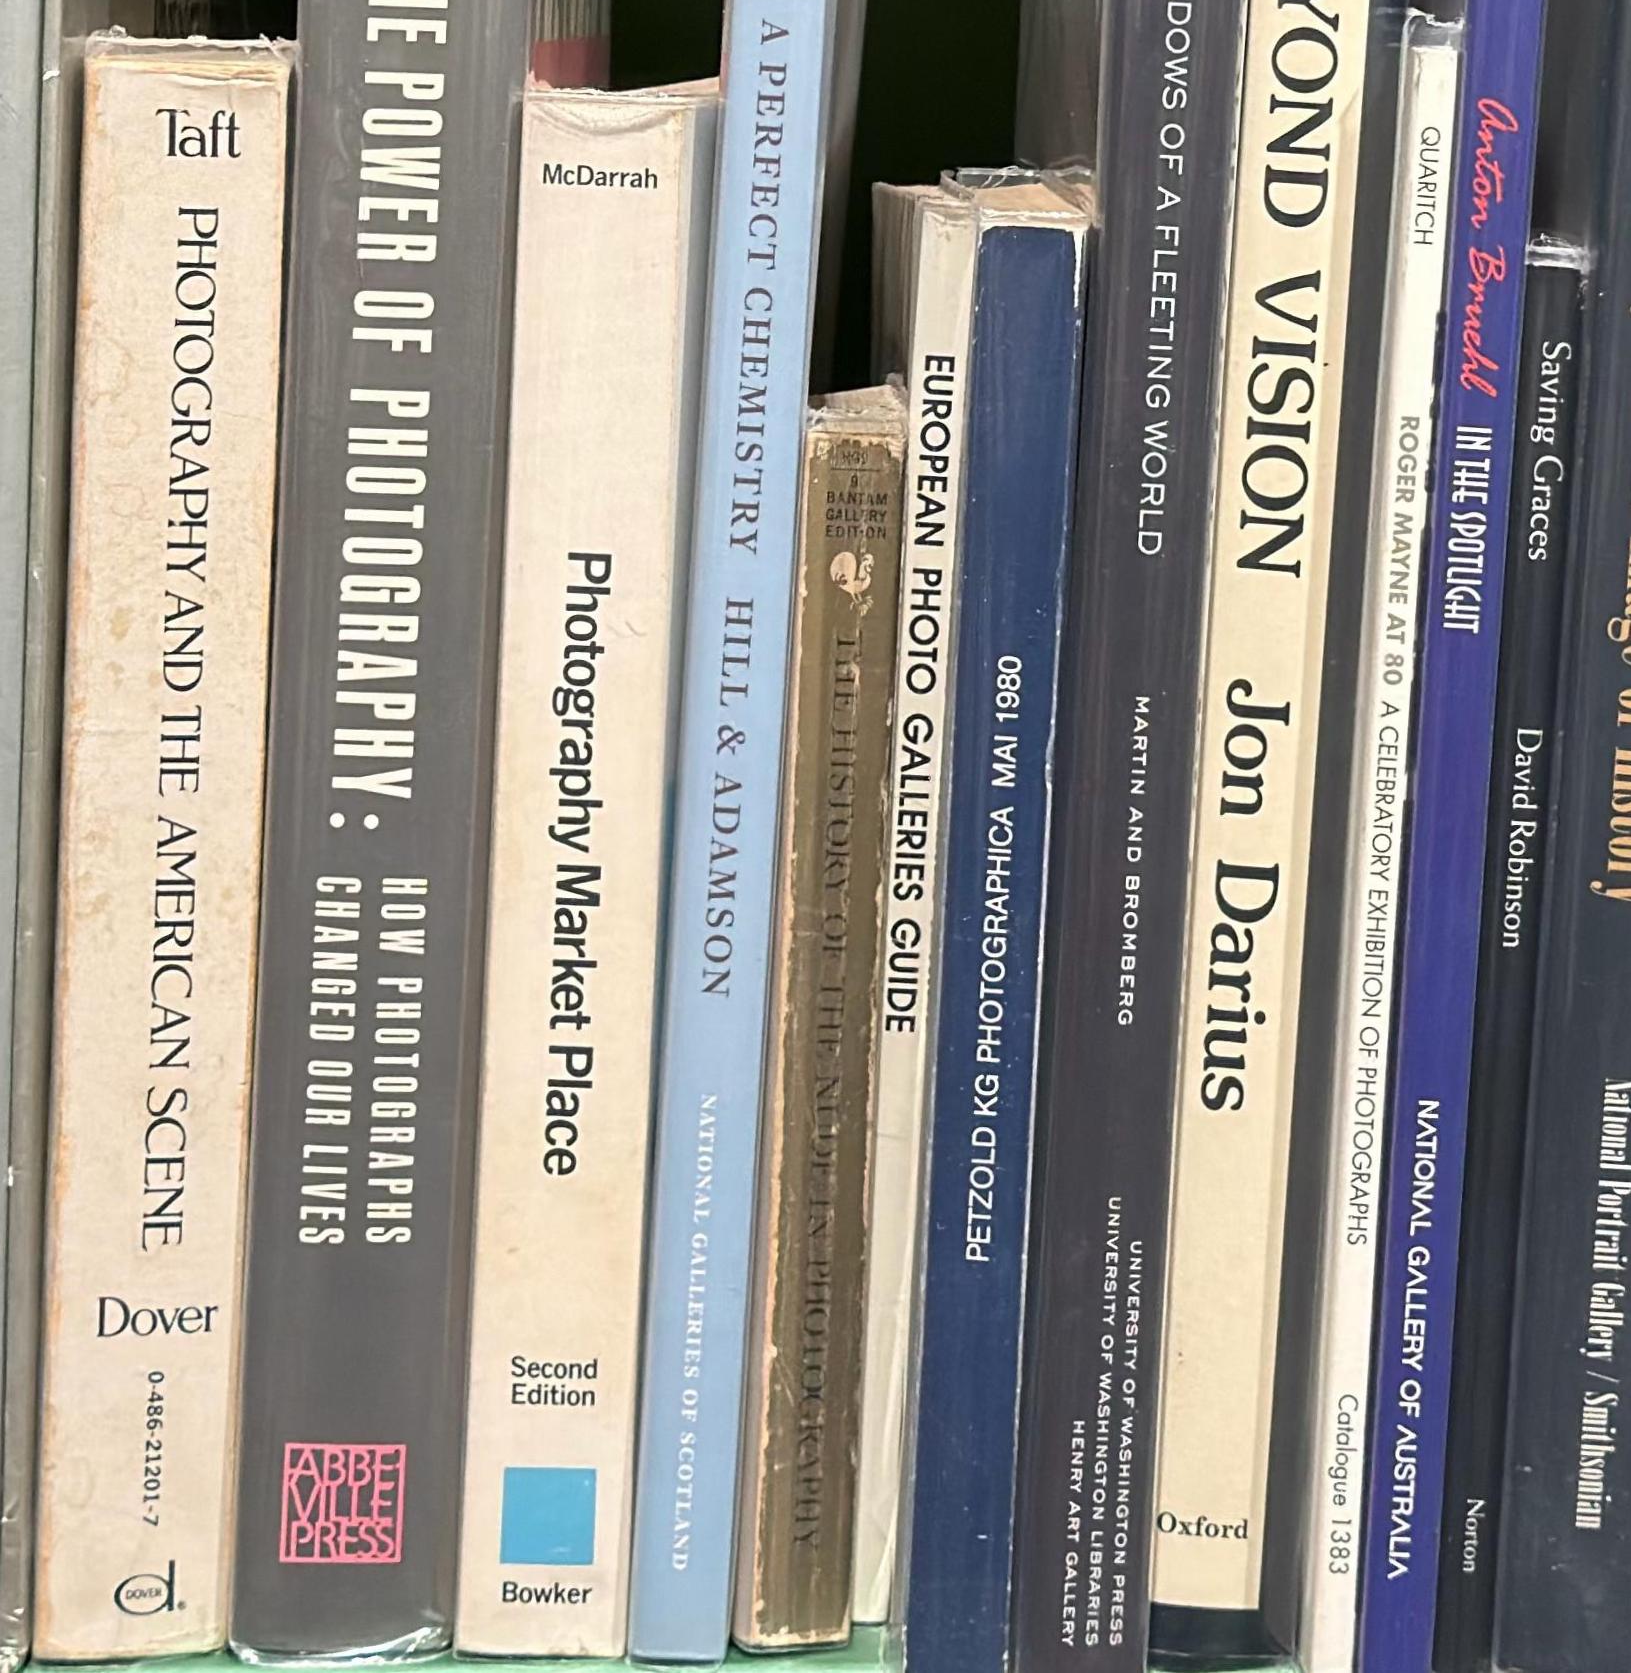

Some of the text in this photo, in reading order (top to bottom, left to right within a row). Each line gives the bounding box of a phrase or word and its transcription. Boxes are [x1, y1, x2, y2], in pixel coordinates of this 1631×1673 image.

[155, 107, 242, 159] Taft
[356, 70, 446, 263] POWER
[541, 163, 659, 190] McDarrah
[1155, 185, 1182, 212] A
[1158, 122, 1186, 177] OF
[1412, 125, 1442, 246] QUARITCH
[352, 289, 436, 354] OF
[1145, 225, 1180, 409] FLEETING
[1442, 97, 1519, 634] Anton Bruehl IN THE SPOTLIGHT
[701, 17, 790, 999] A PERFECT CHEMISTRY HILL & ADAMSON
[1137, 419, 1171, 556] WORLD
[1236, 269, 1322, 579] VISION
[141, 206, 220, 1253] PHOTOGRAPHY AND THE AMERICAN SCENE
[884, 354, 955, 1033] EUROPEAN PHOTO GALLERIES GUIDE
[1501, 340, 1572, 949] Saving Graces David Robinson
[1219, 677, 1291, 817] Jon
[1346, 415, 1421, 1246] ROGER MAYNE AT 80 A CELEBRATORY EXHIBITION OF PHOTOGRAPHS
[1117, 695, 1151, 1027] MARTIN AND BROMBERG
[1199, 858, 1280, 1112] Darius
[96, 1296, 219, 1338] Dover
[510, 1383, 597, 1407] Edition
[672, 1093, 718, 1571] NATIONAL GALLERIES OF SCOTLAND
[1387, 1099, 1440, 1581] NATIONAL GALLERY OF AUSTRALIA
[1578, 1282, 1627, 1362] Gallery
[142, 1370, 166, 1528] 0-486-21201-7
[1109, 1240, 1143, 1646] UNIVERSITY OF WASHINGTON PRESS
[1157, 1510, 1249, 1540] Oxford
[1328, 1393, 1360, 1577] Catalogue 1383
[1574, 1391, 1618, 1531] Smithsonian
[501, 1580, 593, 1605] Bowker
[1061, 1419, 1086, 1647] HENRY ART GALLERY
[1461, 1498, 1486, 1574] Norton
